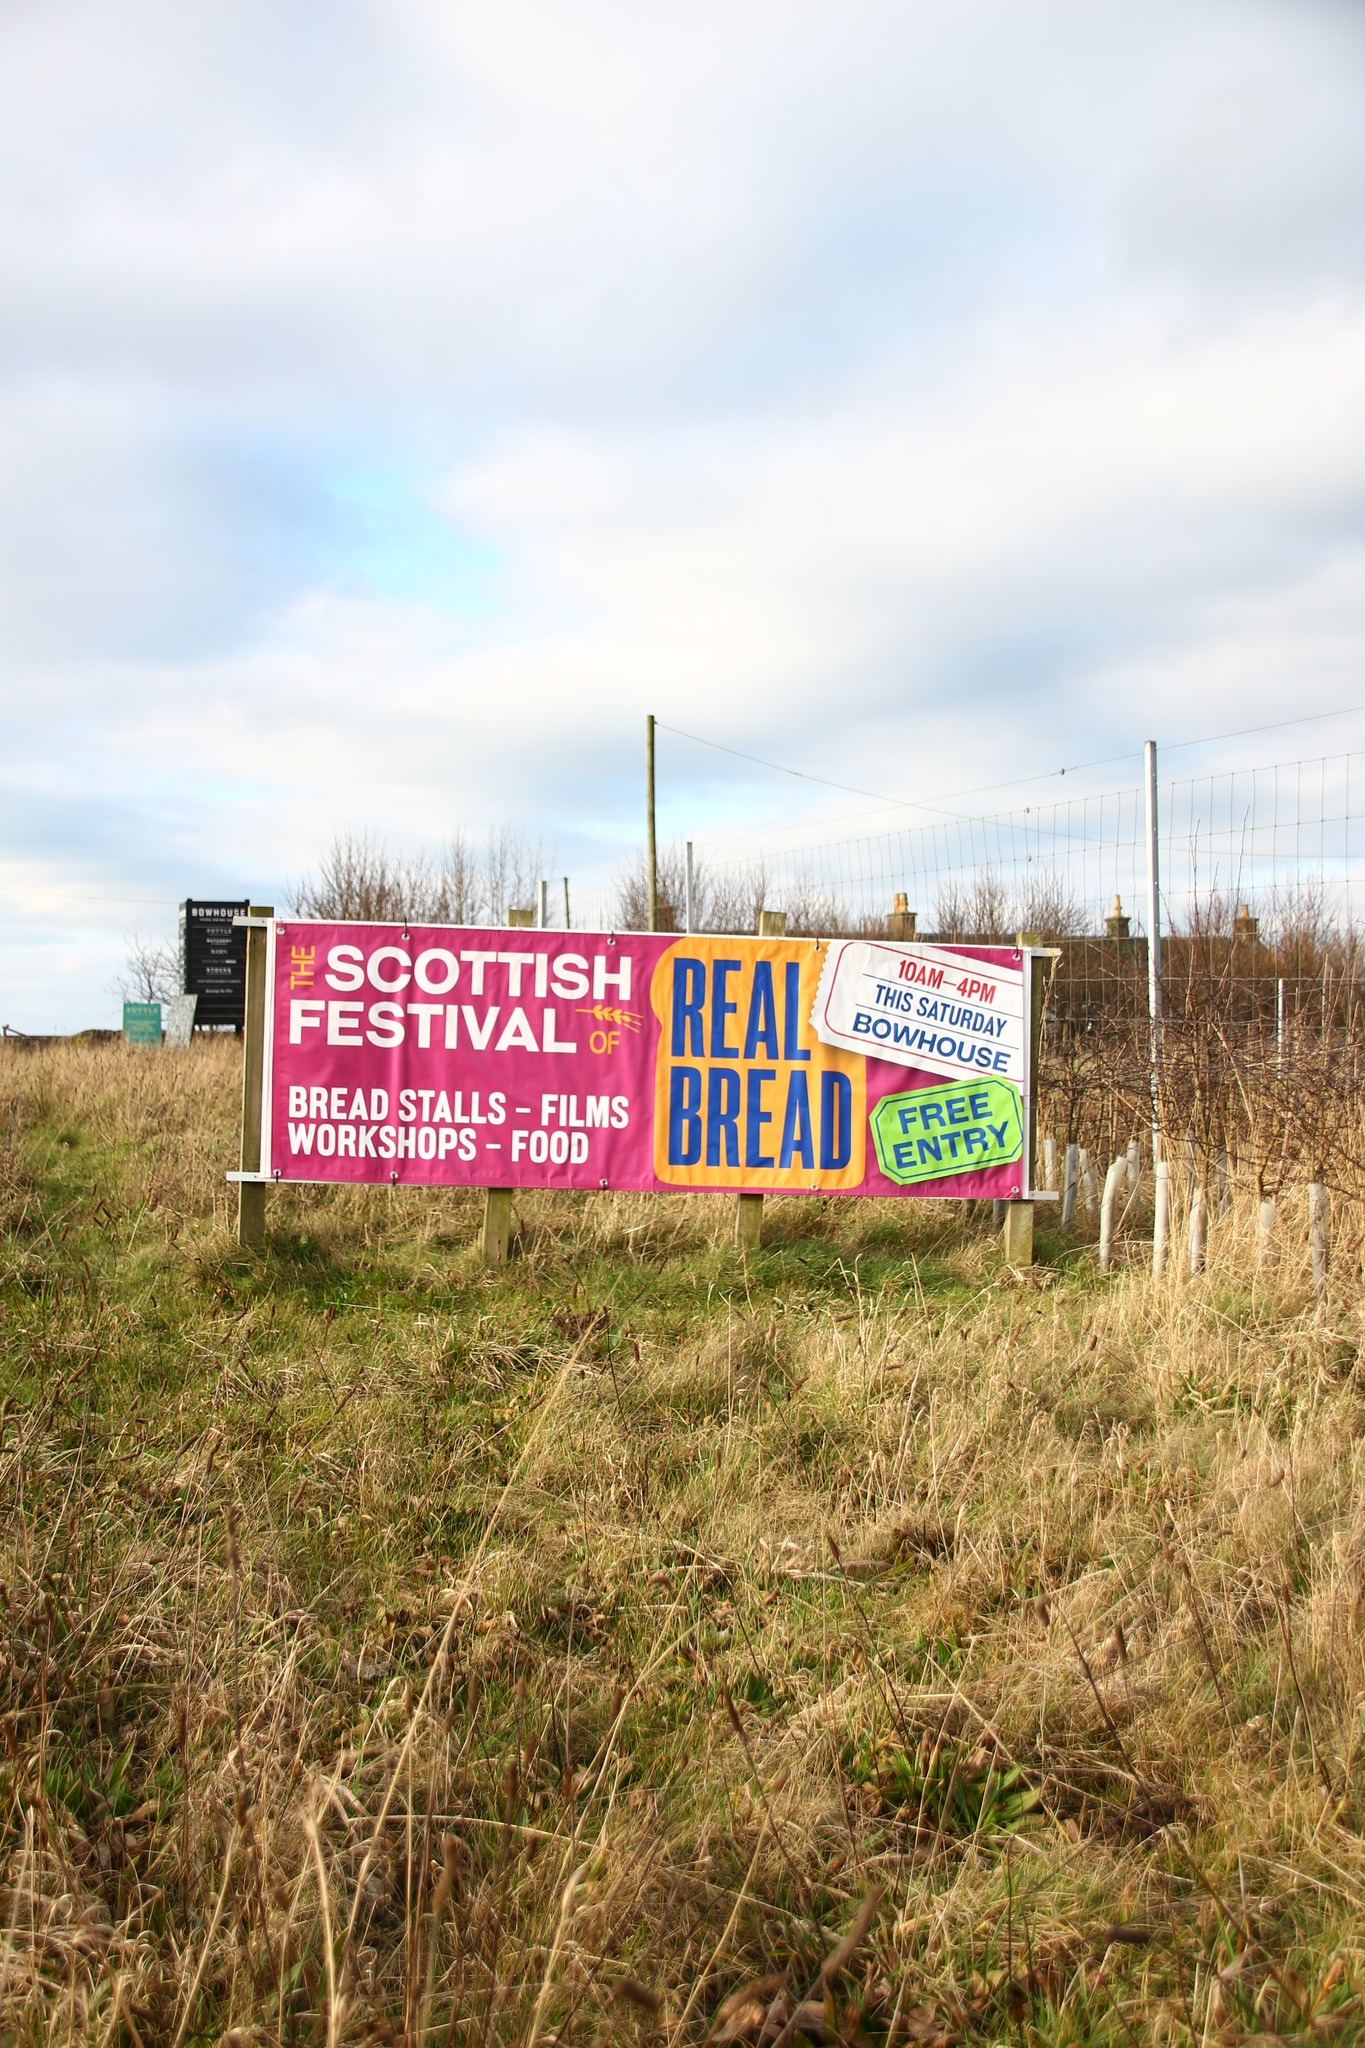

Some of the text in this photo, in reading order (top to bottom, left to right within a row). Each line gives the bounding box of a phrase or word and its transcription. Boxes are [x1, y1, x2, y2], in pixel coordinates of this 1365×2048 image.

[191, 907, 246, 918] BOWHOUSE
[290, 946, 315, 990] THE
[324, 945, 632, 1001] SCOTTISH
[289, 999, 577, 1054] FESTIVAL
[671, 958, 811, 1061] REAL
[874, 984, 1007, 1038] THIS SATURDAY
[589, 1030, 621, 1055] OF
[852, 1012, 1011, 1073] BOWHOUSE
[288, 1086, 389, 1120] BREAD
[398, 1089, 506, 1125] STALLS
[540, 1093, 629, 1128] FILMS
[668, 1066, 852, 1170] BREAD
[898, 1091, 993, 1135] FREE
[287, 1122, 477, 1161] WORKSHOPS
[511, 1130, 589, 1164] FOOD
[892, 1121, 1009, 1170] ENTRY
